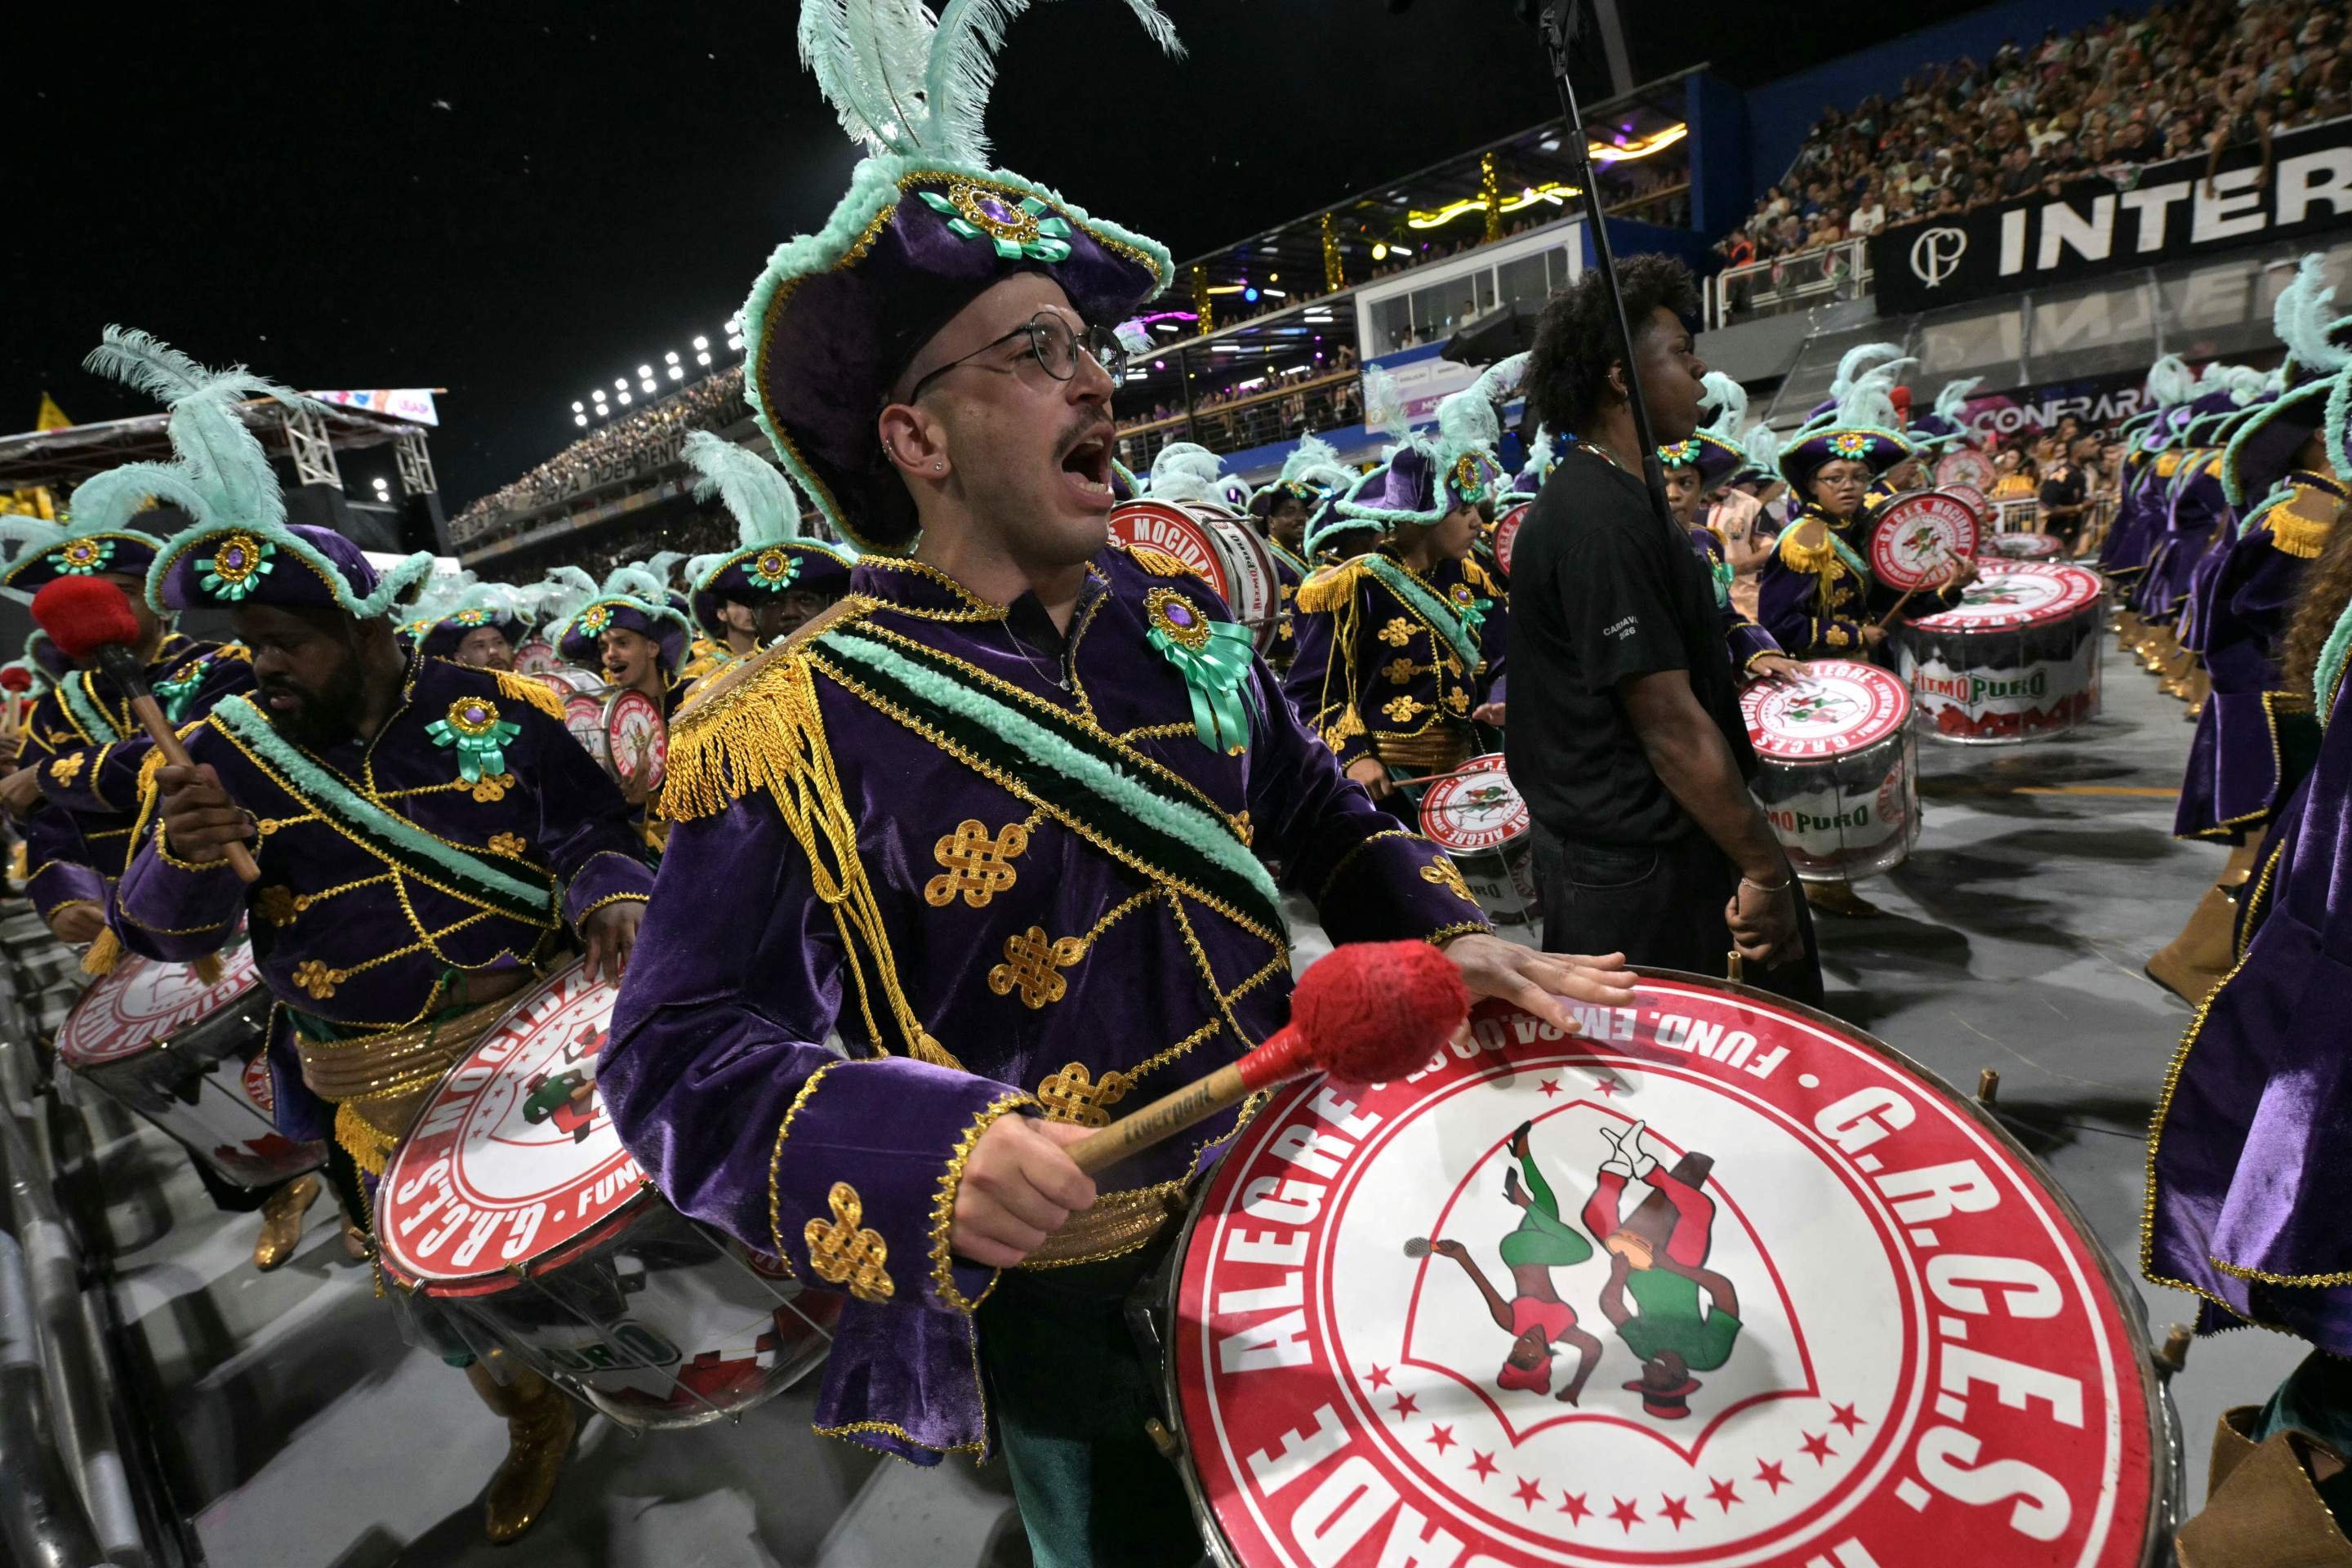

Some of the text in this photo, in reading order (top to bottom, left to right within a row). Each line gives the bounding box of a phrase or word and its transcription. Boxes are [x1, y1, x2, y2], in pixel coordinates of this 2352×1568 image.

[417, 965, 596, 1140] MOCIDA
[577, 1156, 645, 1218] FUN
[1650, 1011, 1791, 1080] FUND.
[1218, 1087, 1383, 1374] ALEGRE
[1814, 1085, 2084, 1542] G.R.C.E.S.
